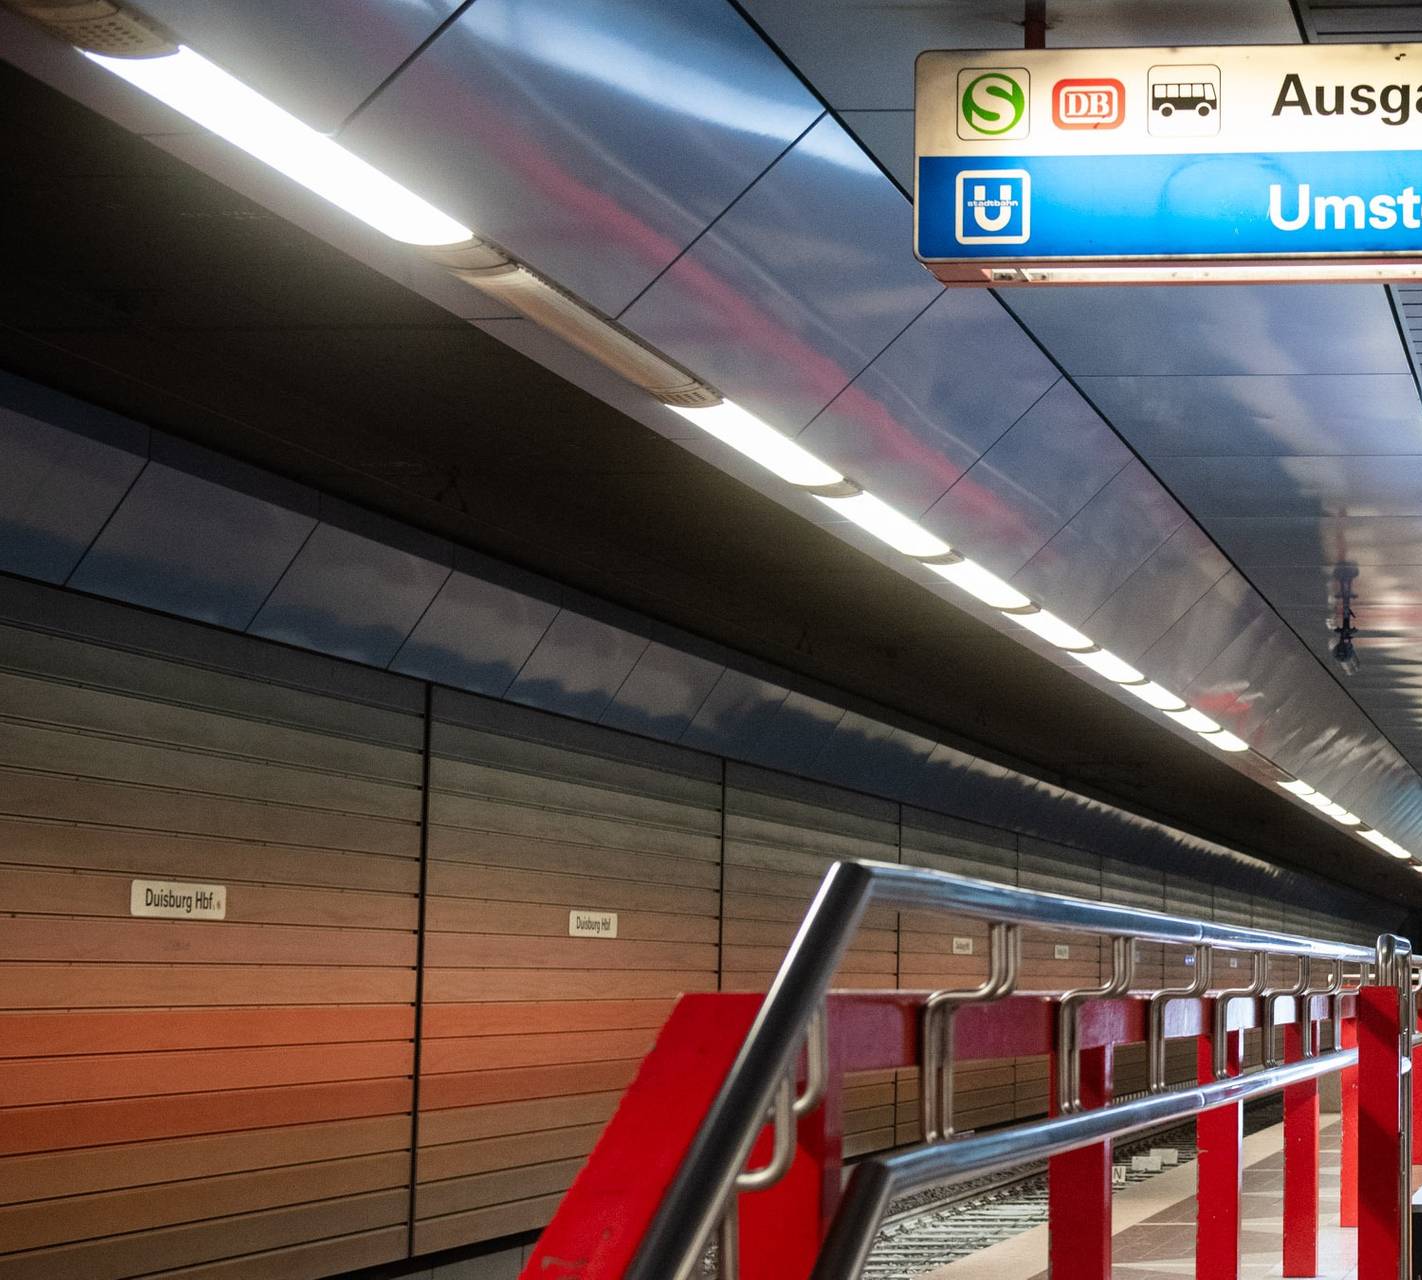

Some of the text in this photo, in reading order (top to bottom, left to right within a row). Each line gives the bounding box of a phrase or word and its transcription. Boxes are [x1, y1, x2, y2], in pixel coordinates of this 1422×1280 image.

[971, 76, 1016, 131] S
[1066, 92, 1110, 116] DB
[973, 184, 1012, 232] U
[145, 887, 193, 914] Duisburg
[576, 915, 601, 934] Duisburg
